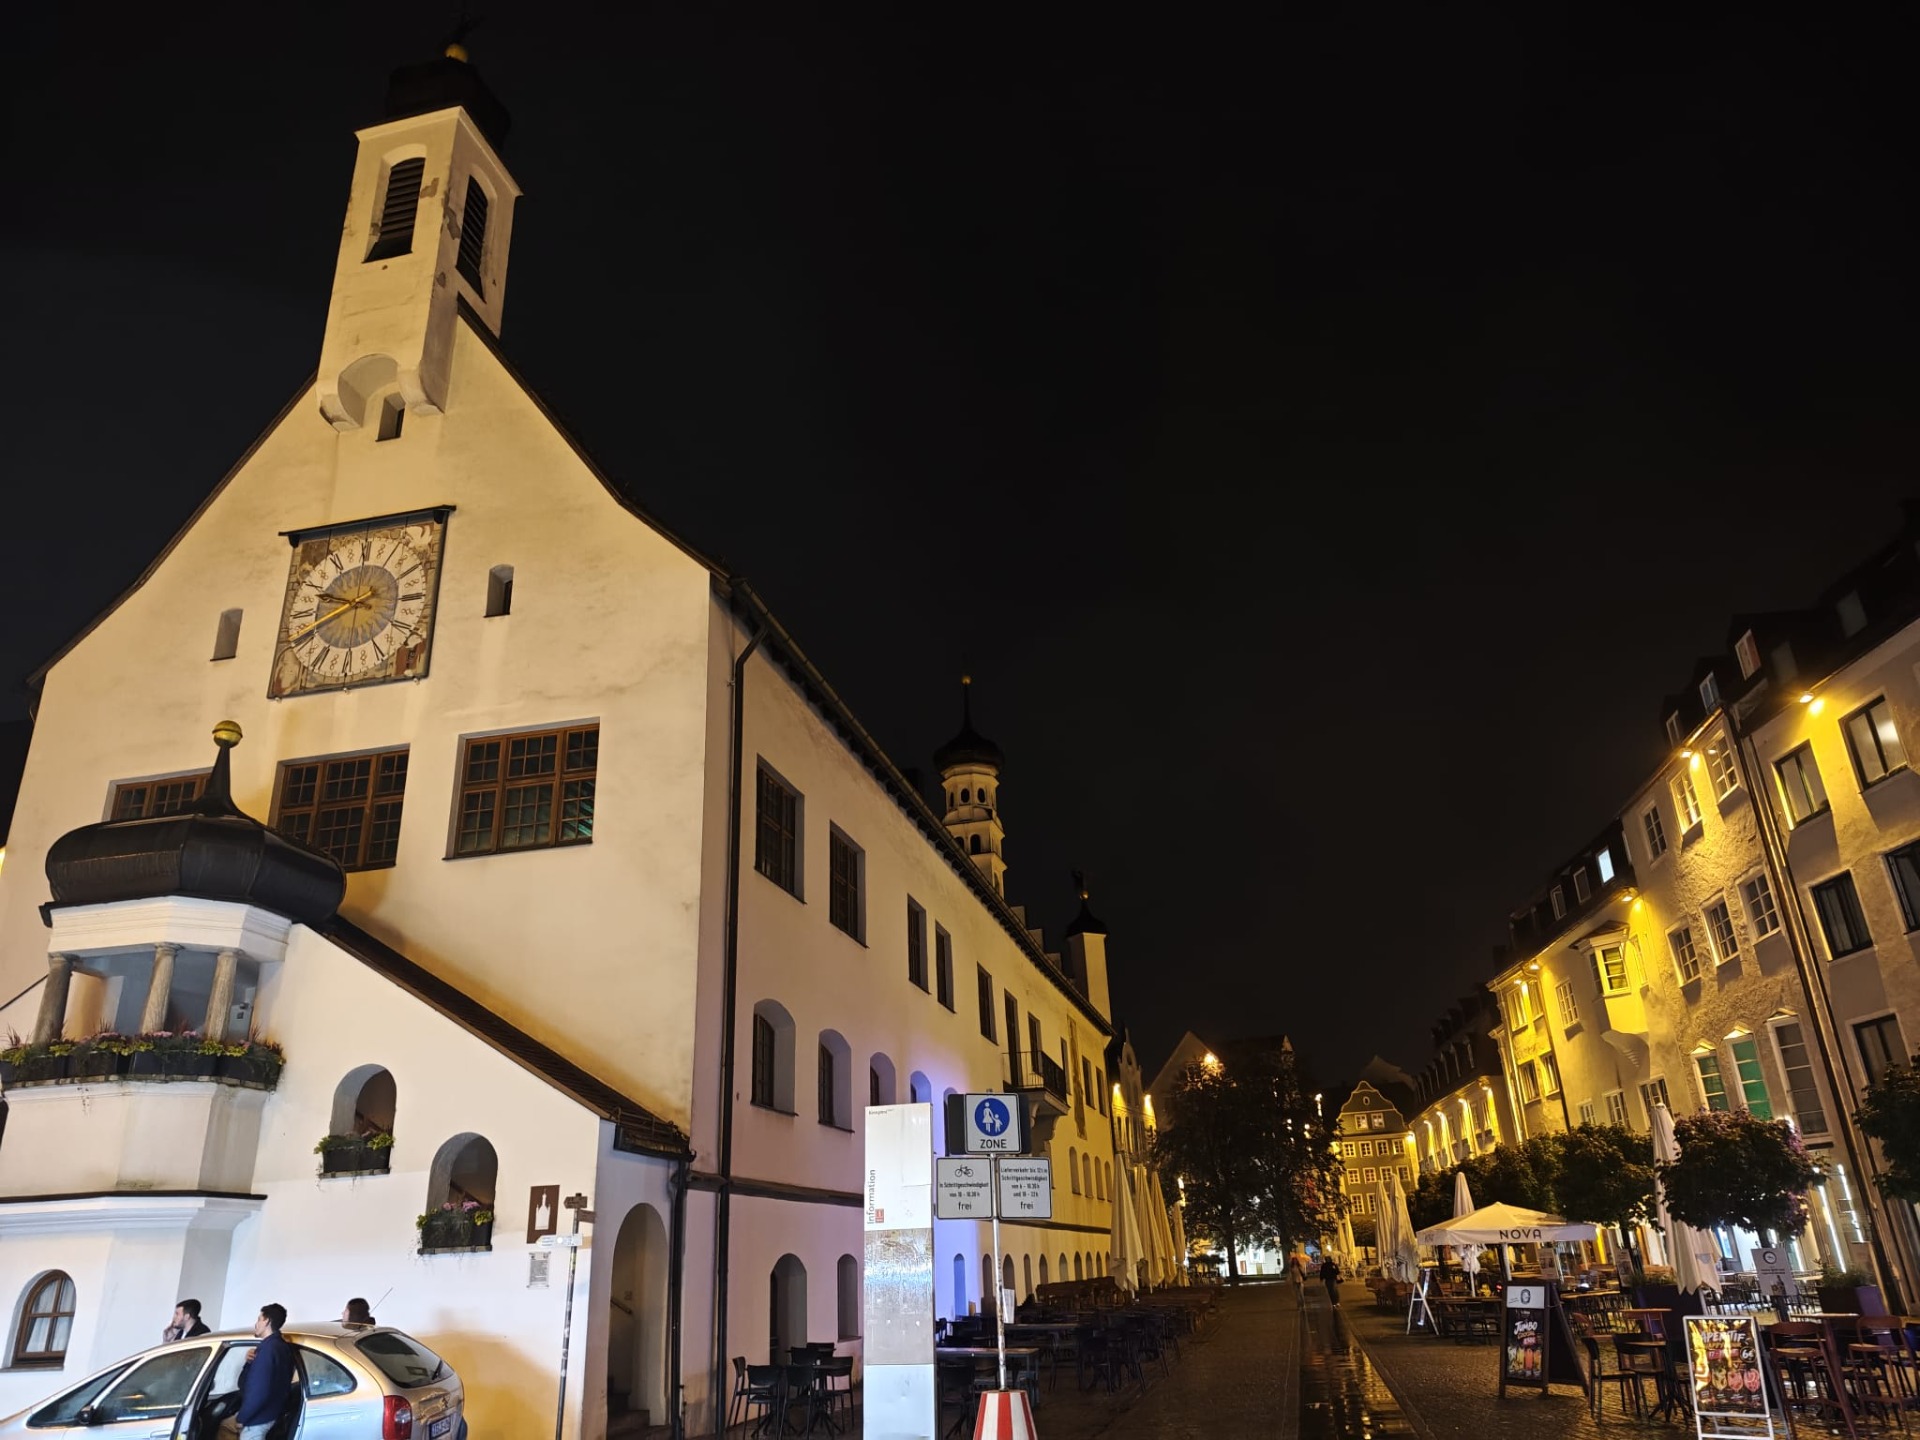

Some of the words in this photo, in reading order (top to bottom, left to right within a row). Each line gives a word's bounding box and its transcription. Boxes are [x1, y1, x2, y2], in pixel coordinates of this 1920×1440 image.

[980, 1138, 1007, 1149] ZONE
[866, 1169, 875, 1224] Information
[958, 1201, 972, 1210] frei
[1020, 1201, 1034, 1210] frei
[1500, 1228, 1542, 1240] NOVA
[1513, 1320, 1538, 1335] JUMBO
